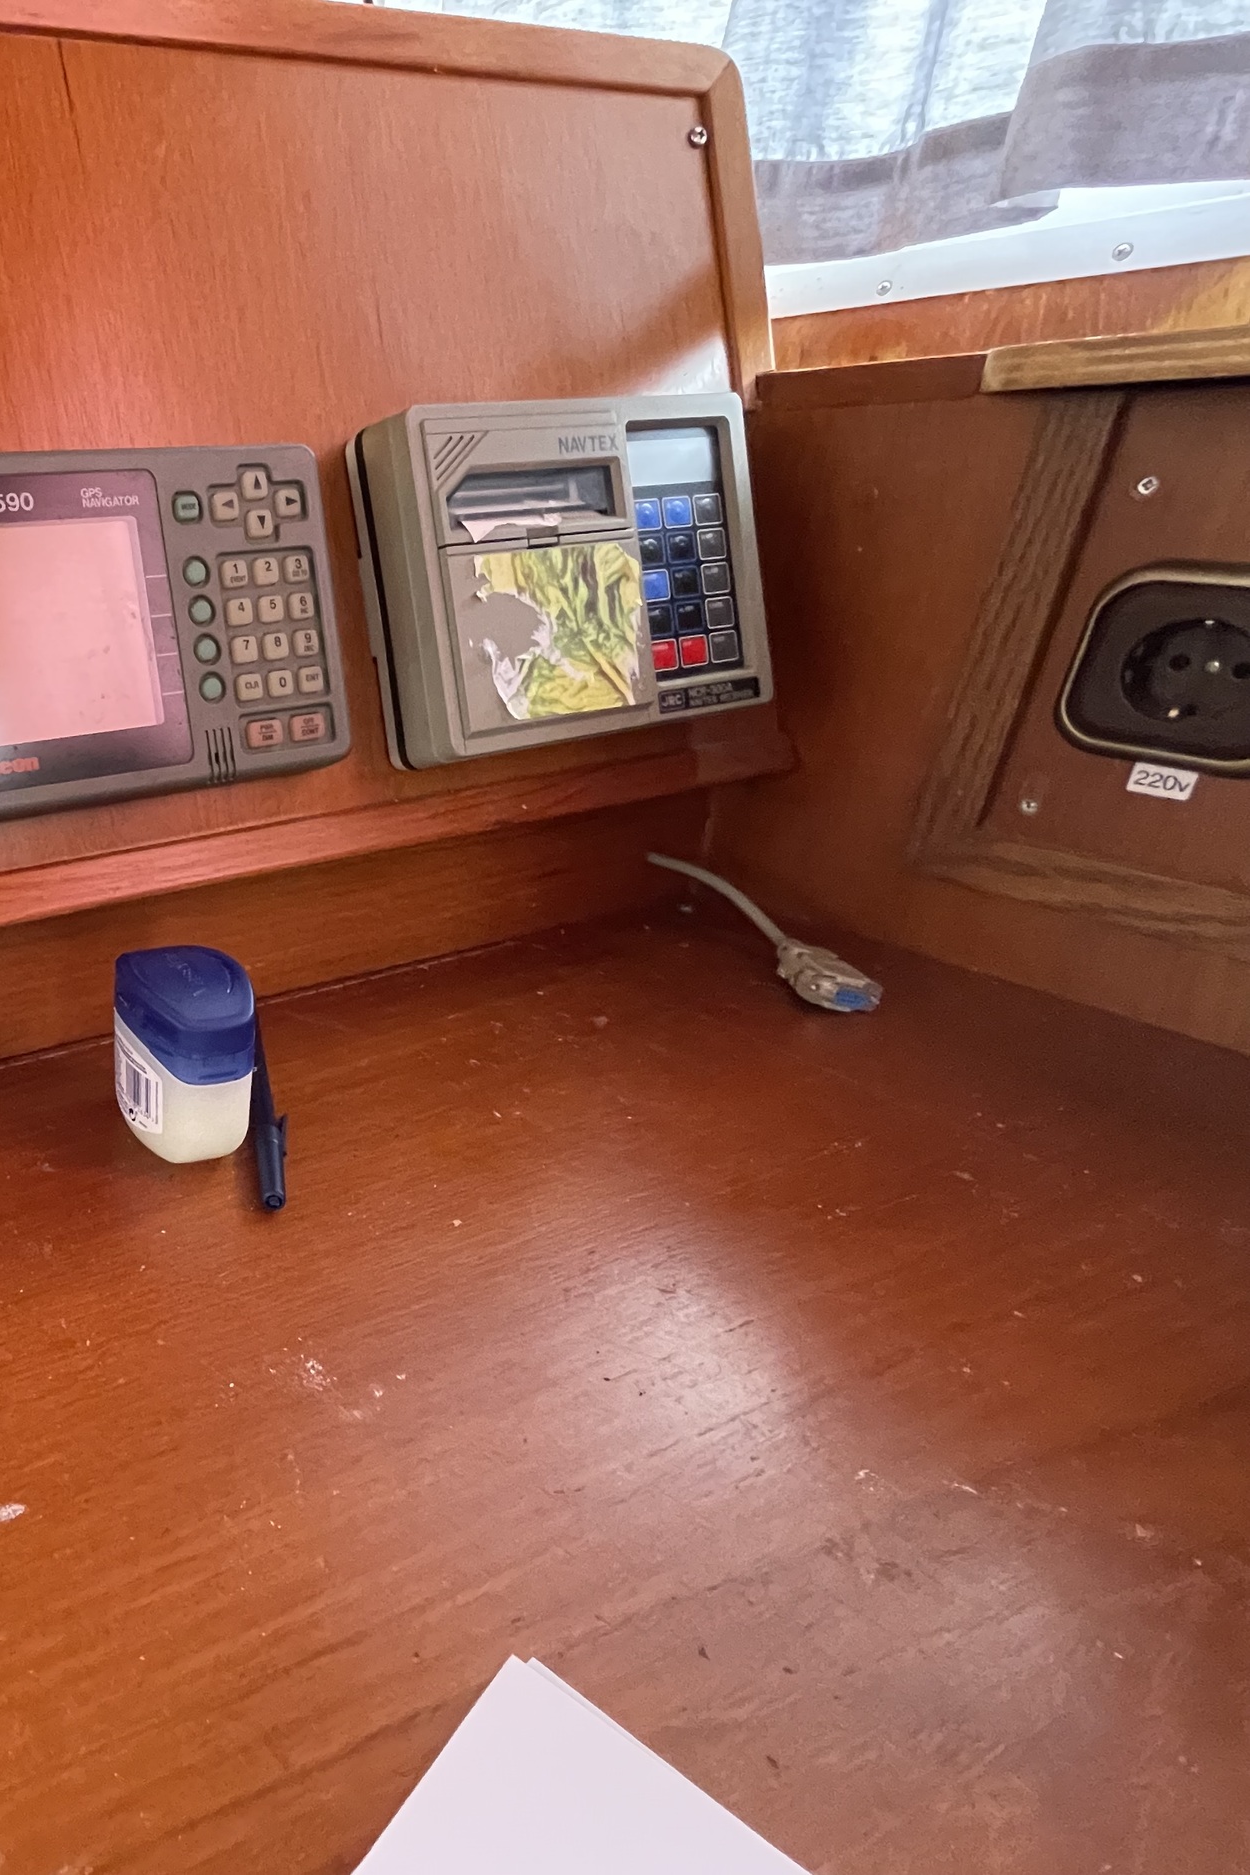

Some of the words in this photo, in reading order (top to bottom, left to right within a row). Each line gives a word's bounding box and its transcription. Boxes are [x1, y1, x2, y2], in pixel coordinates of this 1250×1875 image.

[558, 434, 619, 454] NAVTEX
[80, 487, 103, 499] GPS
[81, 495, 140, 508] NAVIGATOR
[232, 563, 239, 574] 1
[264, 561, 272, 572] 2
[294, 558, 302, 569] 3
[237, 601, 245, 612] 4
[269, 599, 277, 610] 5
[299, 596, 307, 607] 6
[274, 636, 282, 648] 8
[304, 633, 312, 644] 9
[243, 639, 250, 650] 7
